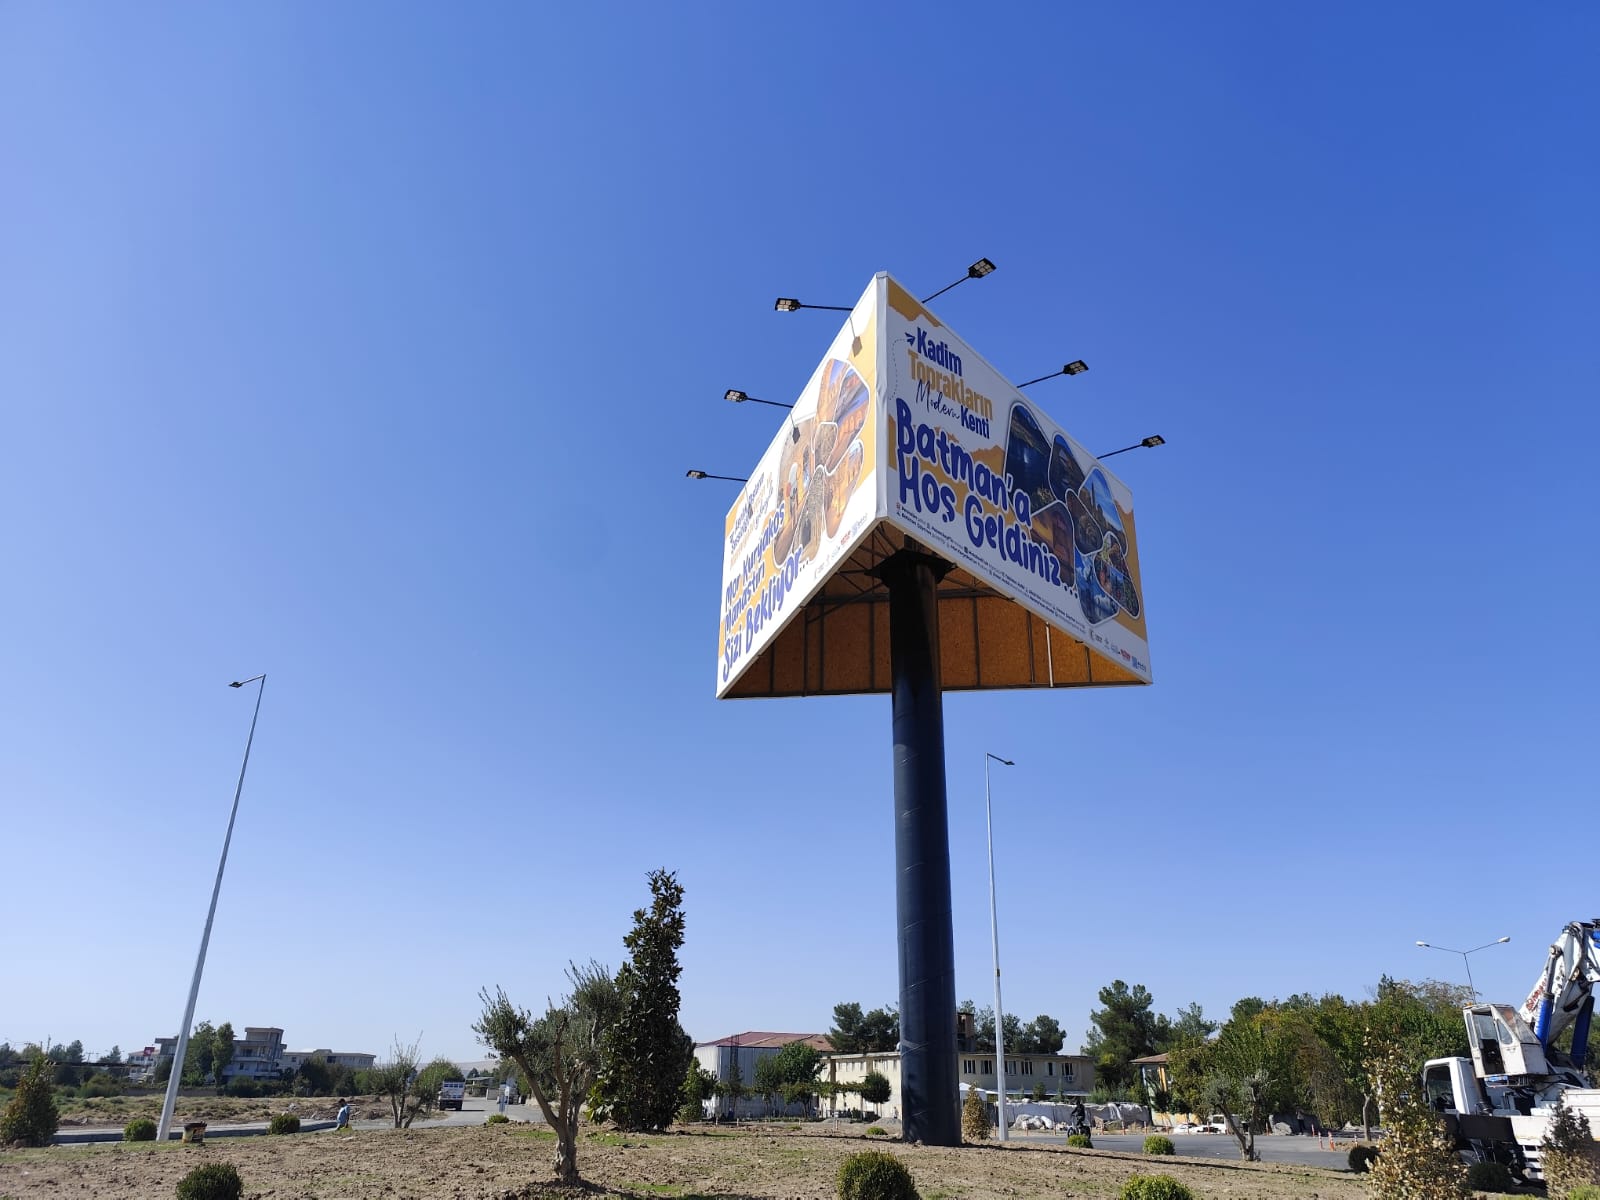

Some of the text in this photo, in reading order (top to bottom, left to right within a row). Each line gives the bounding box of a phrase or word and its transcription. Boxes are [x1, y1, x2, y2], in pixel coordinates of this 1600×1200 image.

[917, 326, 962, 376] Kadim
[916, 379, 990, 438] Modern Kenti
[896, 398, 1032, 527] Batman'a
[898, 447, 956, 523] Hoş
[726, 573, 741, 613] Mor
[743, 502, 785, 587] Kuryakos
[723, 623, 742, 682] Sizi
